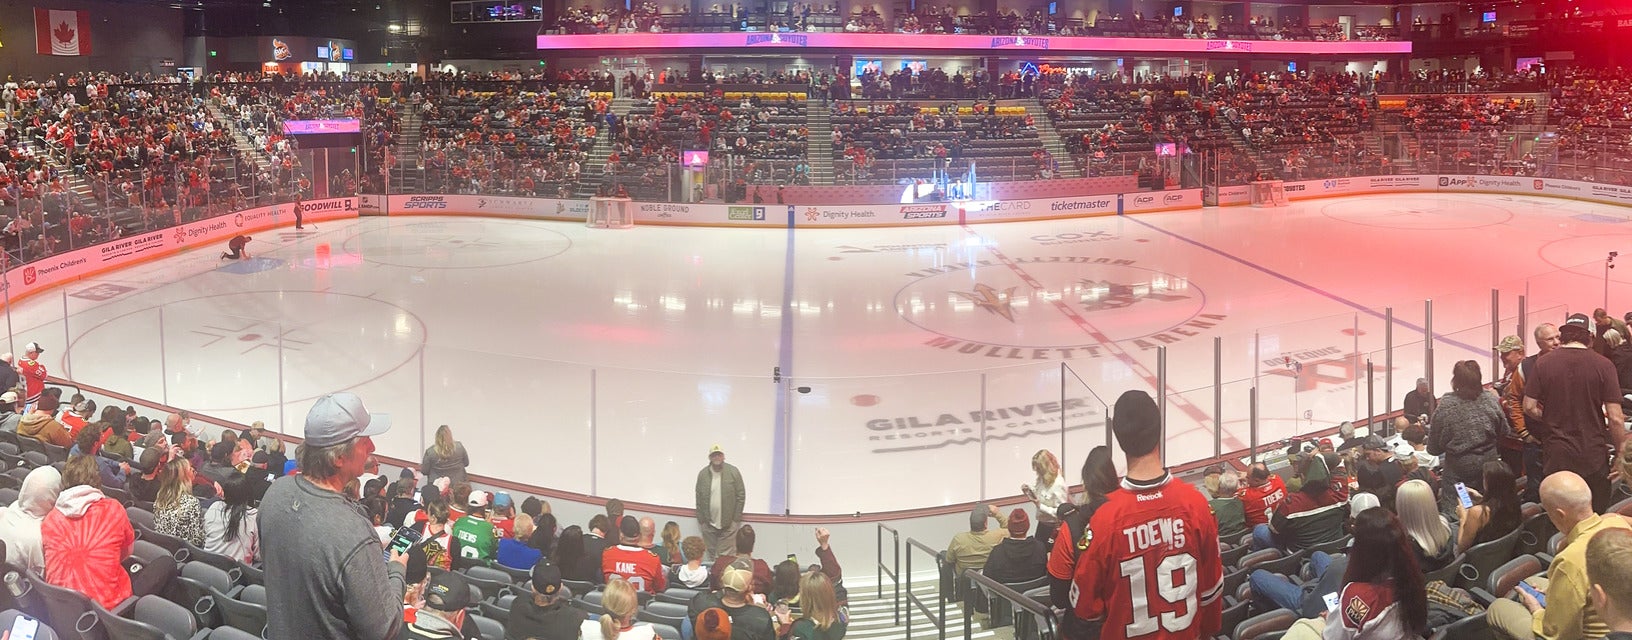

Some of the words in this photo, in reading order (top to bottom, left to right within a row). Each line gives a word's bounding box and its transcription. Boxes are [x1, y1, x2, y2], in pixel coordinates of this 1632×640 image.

[404, 201, 448, 209] SPORTS
[640, 204, 661, 212] NOBLE
[663, 204, 690, 213] GROUND
[1051, 199, 1110, 211] ticketmaster
[823, 210, 849, 219] Dignity
[907, 211, 944, 219] SPORTS
[188, 226, 208, 237] Dignity
[208, 221, 227, 232] Health
[134, 237, 147, 245] GILA
[147, 233, 163, 242] RIVER
[101, 245, 115, 254] GILA
[115, 241, 132, 251] RIVER
[38, 264, 59, 276] Phoenix
[60, 257, 87, 269] Children's
[924, 336, 1105, 360] MULLETT
[1133, 313, 1228, 351] ARENA
[865, 413, 963, 431] GILA
[968, 396, 1089, 423] RIVER
[869, 426, 973, 440] RESORTS
[1136, 491, 1164, 502] Reebok
[1262, 488, 1285, 507] TOEWS
[1123, 517, 1186, 554] TOEWS
[615, 561, 637, 574] KANE
[1119, 552, 1198, 638] 19
